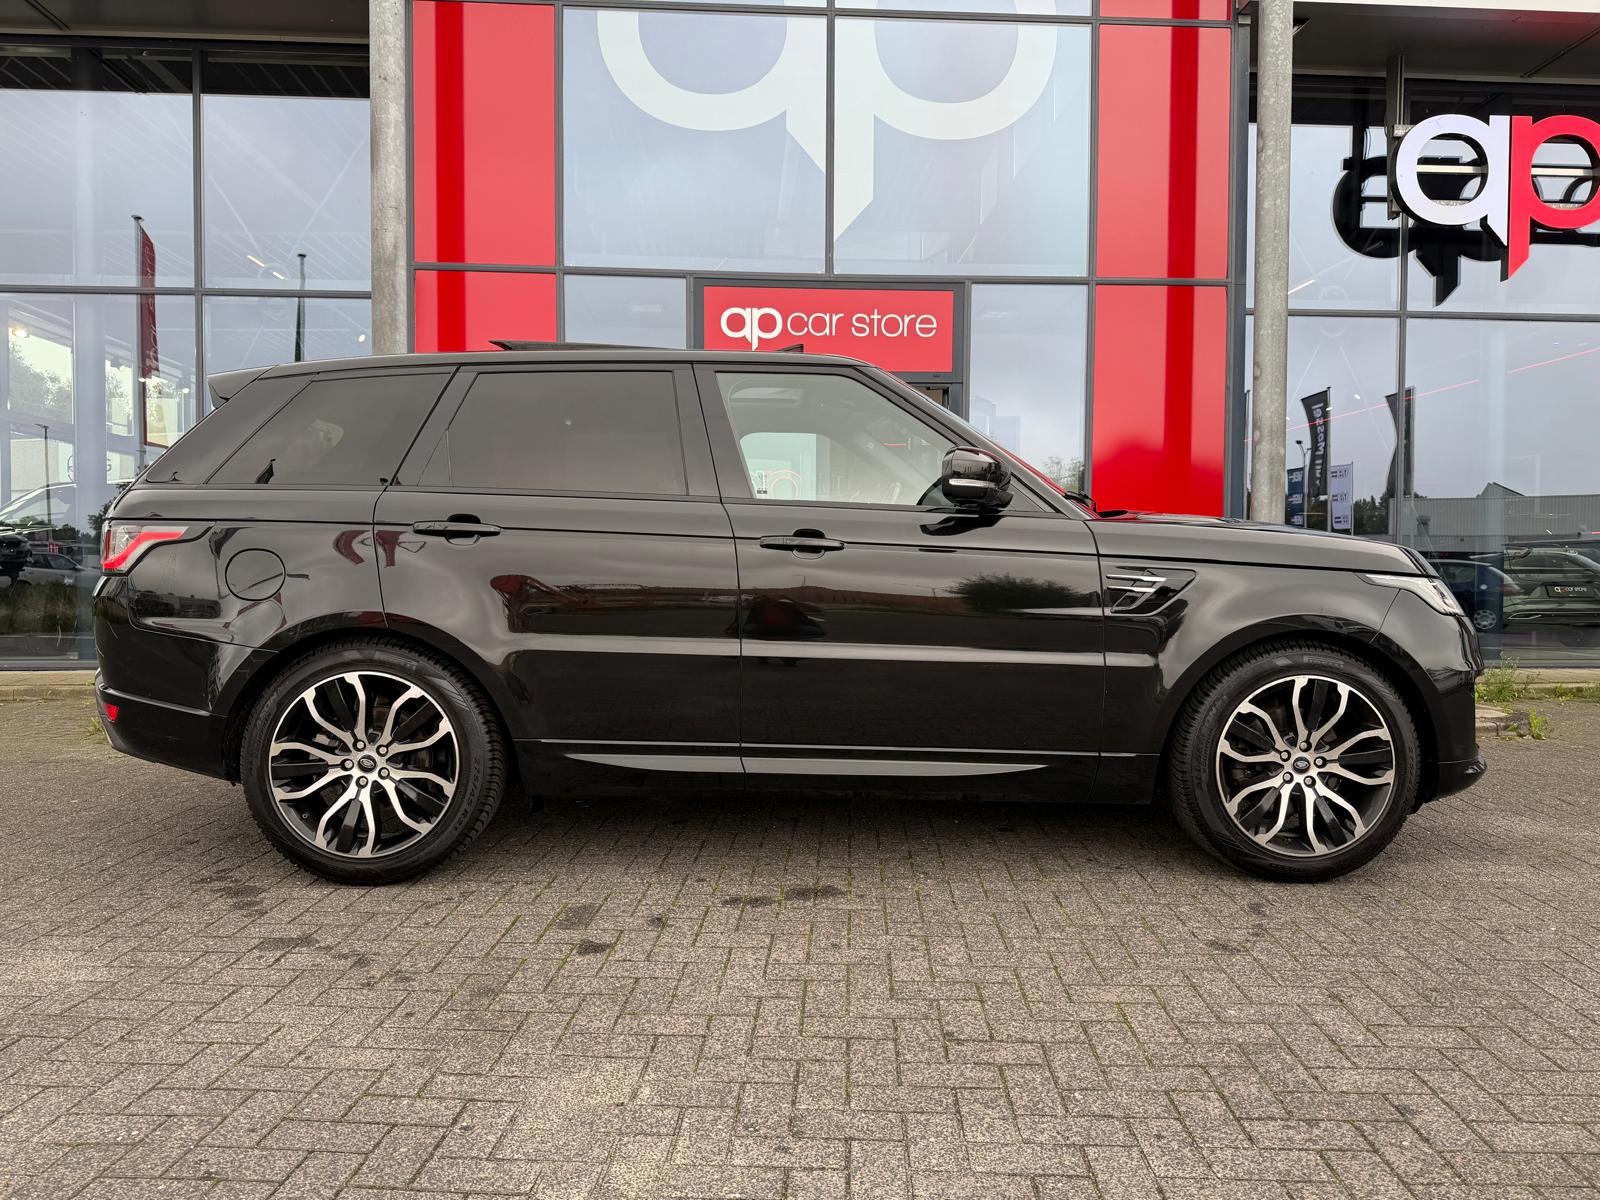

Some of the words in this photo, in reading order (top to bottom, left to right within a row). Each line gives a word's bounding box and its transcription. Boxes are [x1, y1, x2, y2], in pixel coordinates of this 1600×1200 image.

[1396, 113, 1600, 280] ap
[720, 306, 783, 351] ap
[787, 312, 844, 337] car
[851, 308, 938, 338] store
